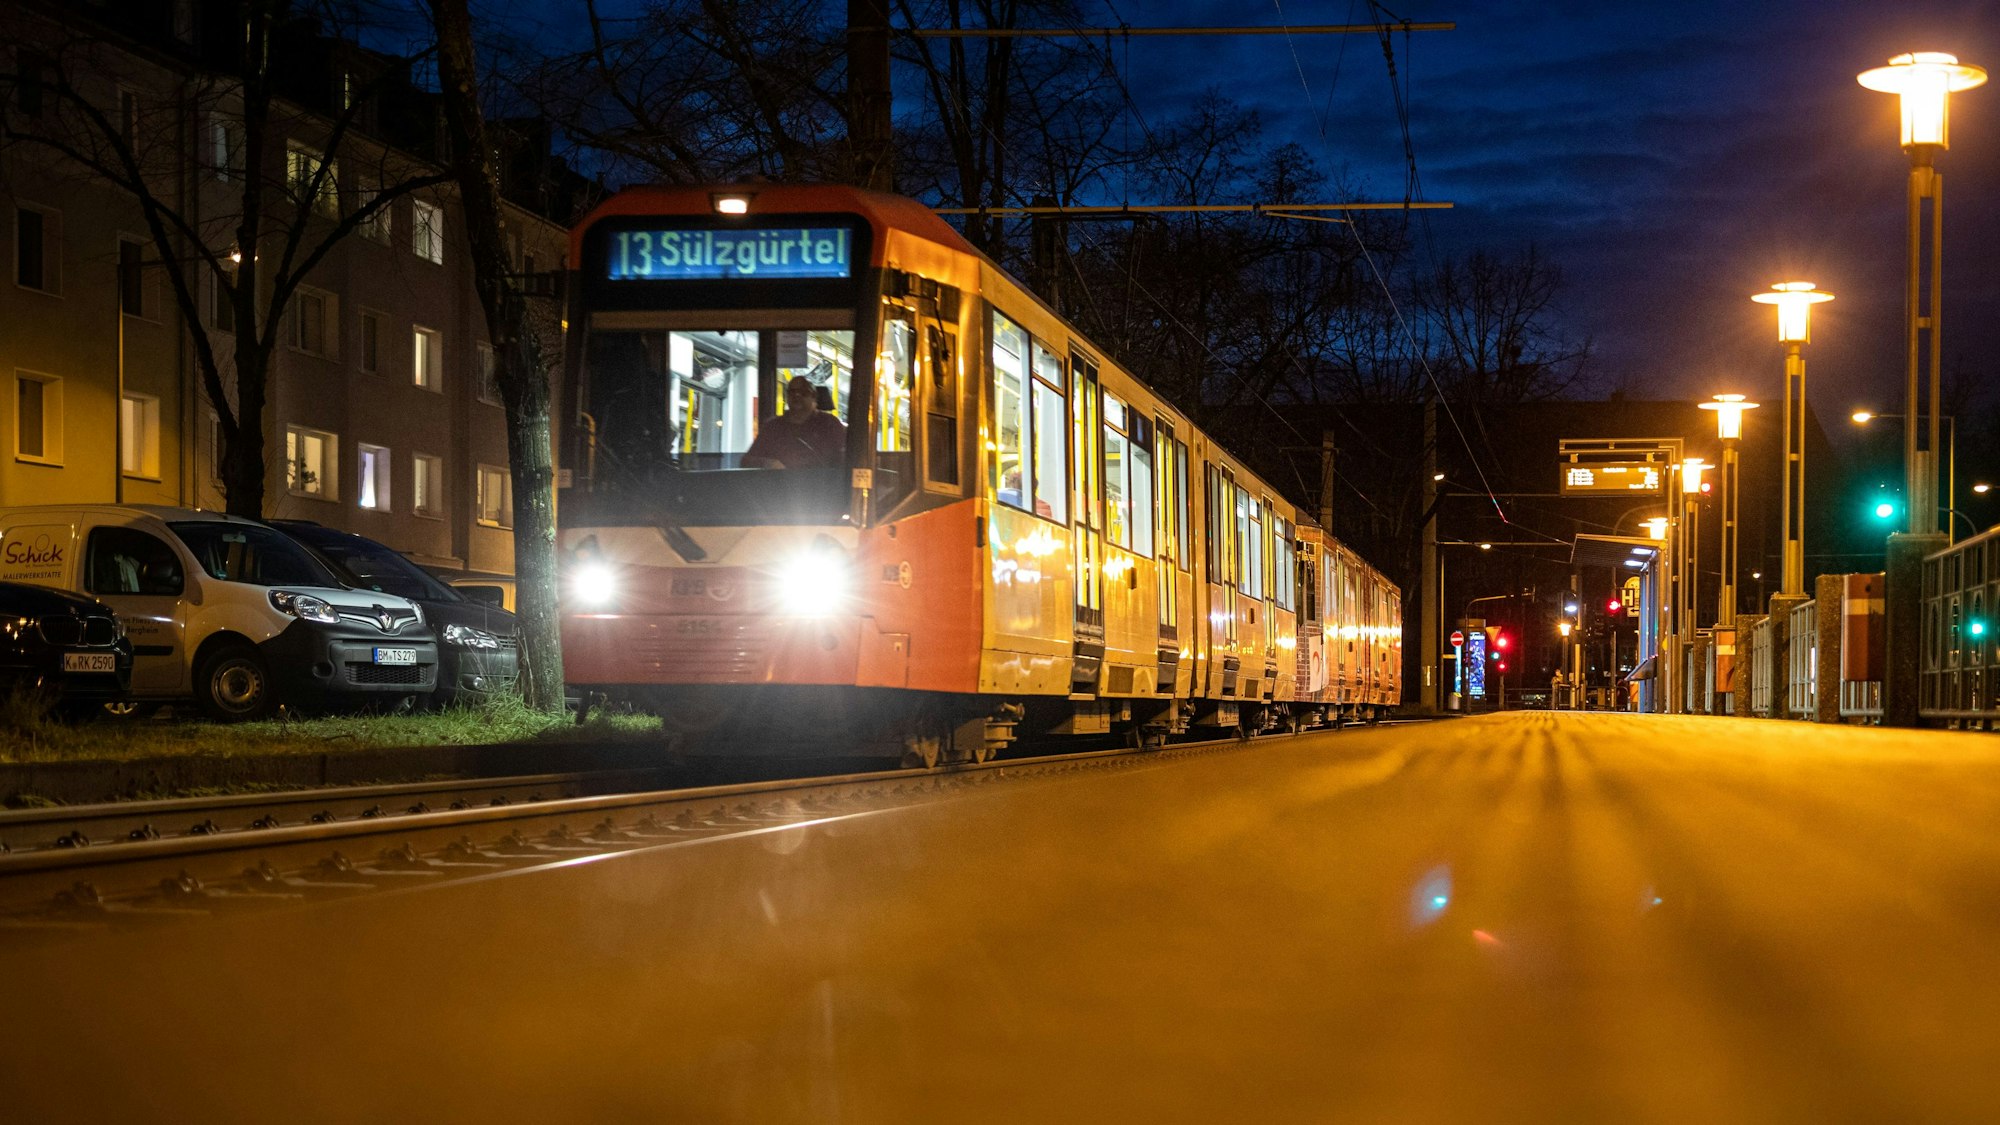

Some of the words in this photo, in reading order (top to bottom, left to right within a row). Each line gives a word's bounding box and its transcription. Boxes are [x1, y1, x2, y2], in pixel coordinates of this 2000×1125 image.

[618, 231, 651, 276] 13
[660, 228, 845, 275] Sülzgürtel
[5, 541, 63, 565] Schick
[1621, 589, 1634, 606] H
[65, 655, 72, 670] K
[78, 655, 90, 670] RK
[91, 655, 114, 670] 2590
[378, 650, 388, 661] BM
[392, 650, 402, 661] TS
[403, 650, 416, 662] 279
